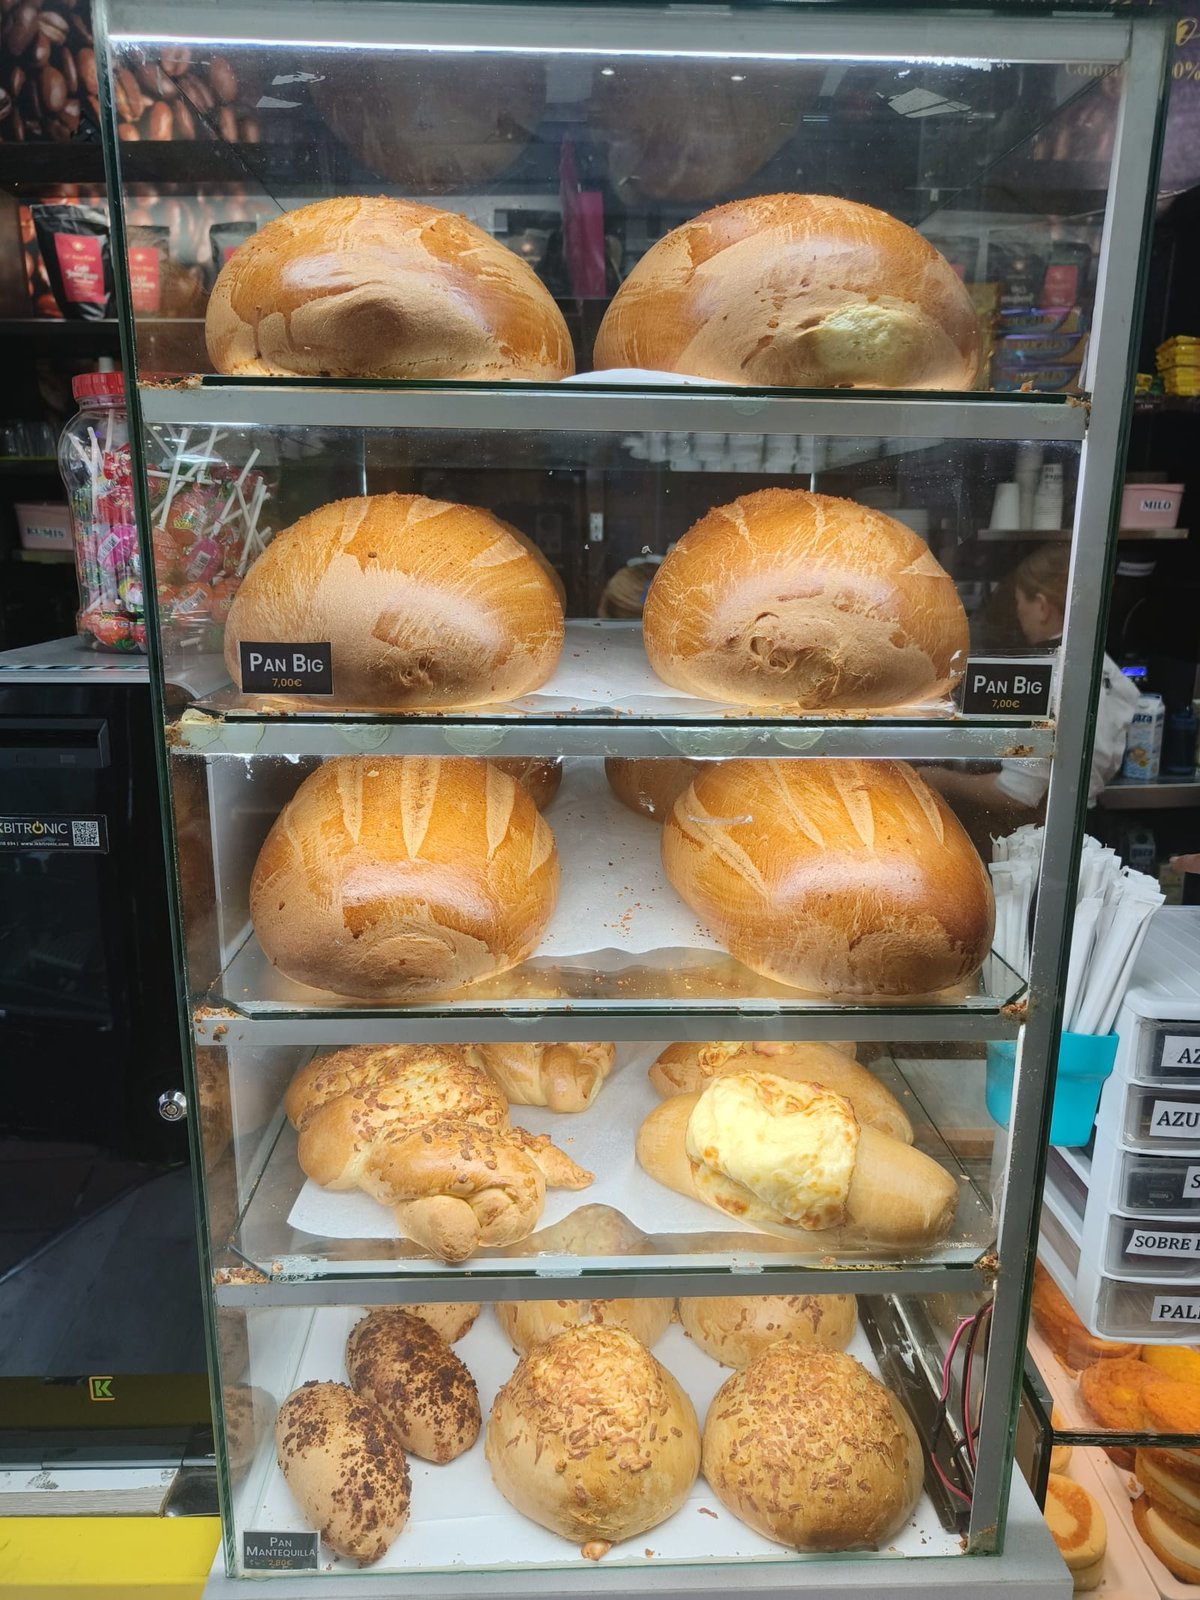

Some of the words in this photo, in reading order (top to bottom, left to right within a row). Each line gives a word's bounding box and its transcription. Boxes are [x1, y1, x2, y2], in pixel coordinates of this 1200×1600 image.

[1143, 501, 1171, 510] MILO
[272, 678, 302, 688] 7,00€
[992, 699, 1020, 709] 7,00€
[1134, 1235, 1192, 1250] SOBRE
[1159, 1304, 1200, 1319] PAL
